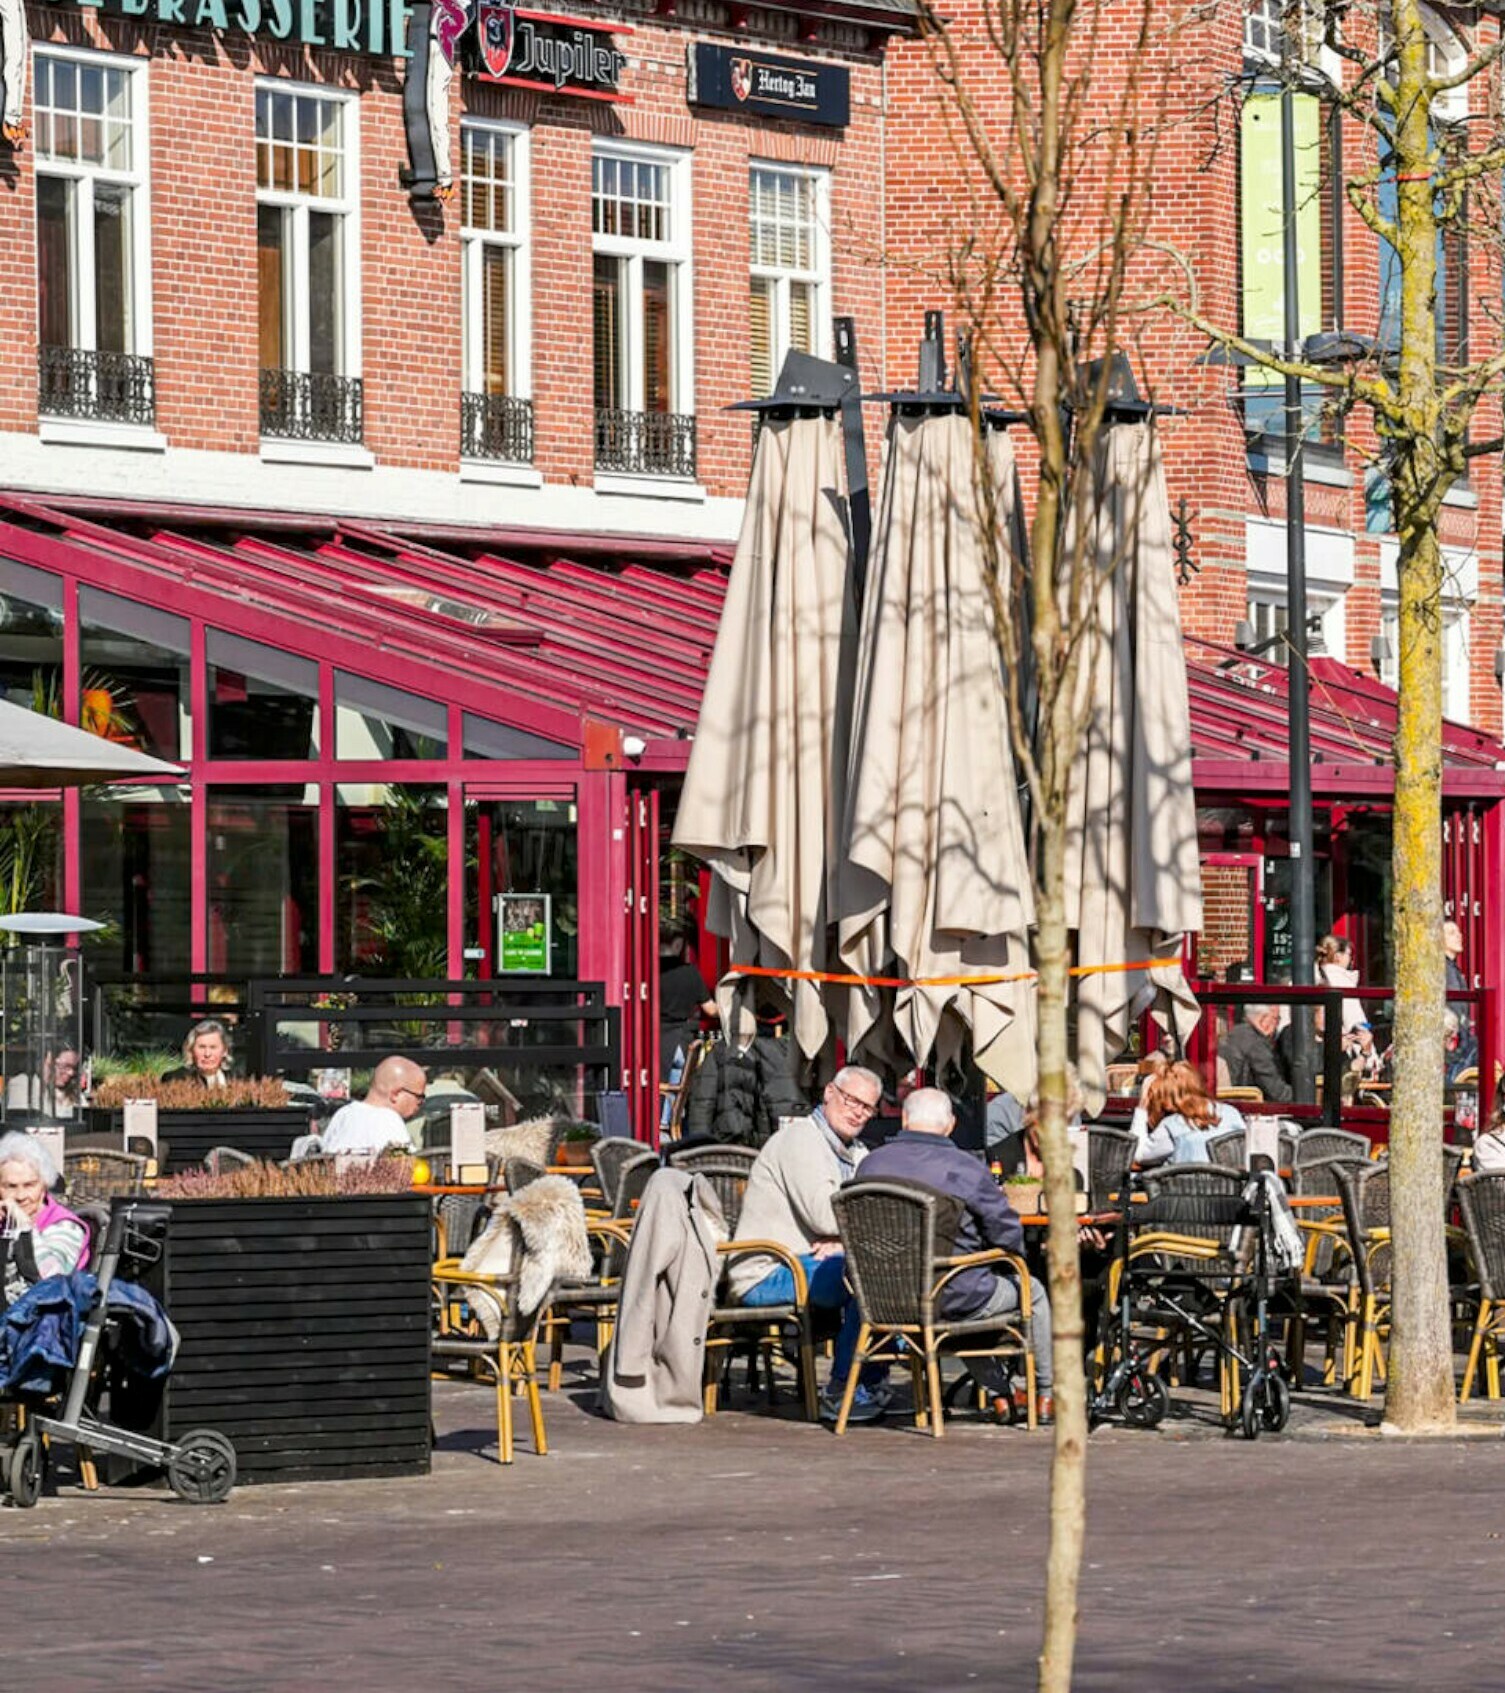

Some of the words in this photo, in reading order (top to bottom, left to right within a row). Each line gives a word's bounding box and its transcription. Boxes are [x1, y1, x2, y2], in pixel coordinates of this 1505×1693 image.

[516, 23, 627, 88] Jupiler
[758, 69, 795, 98] Hertog
[795, 75, 816, 98] Jan
